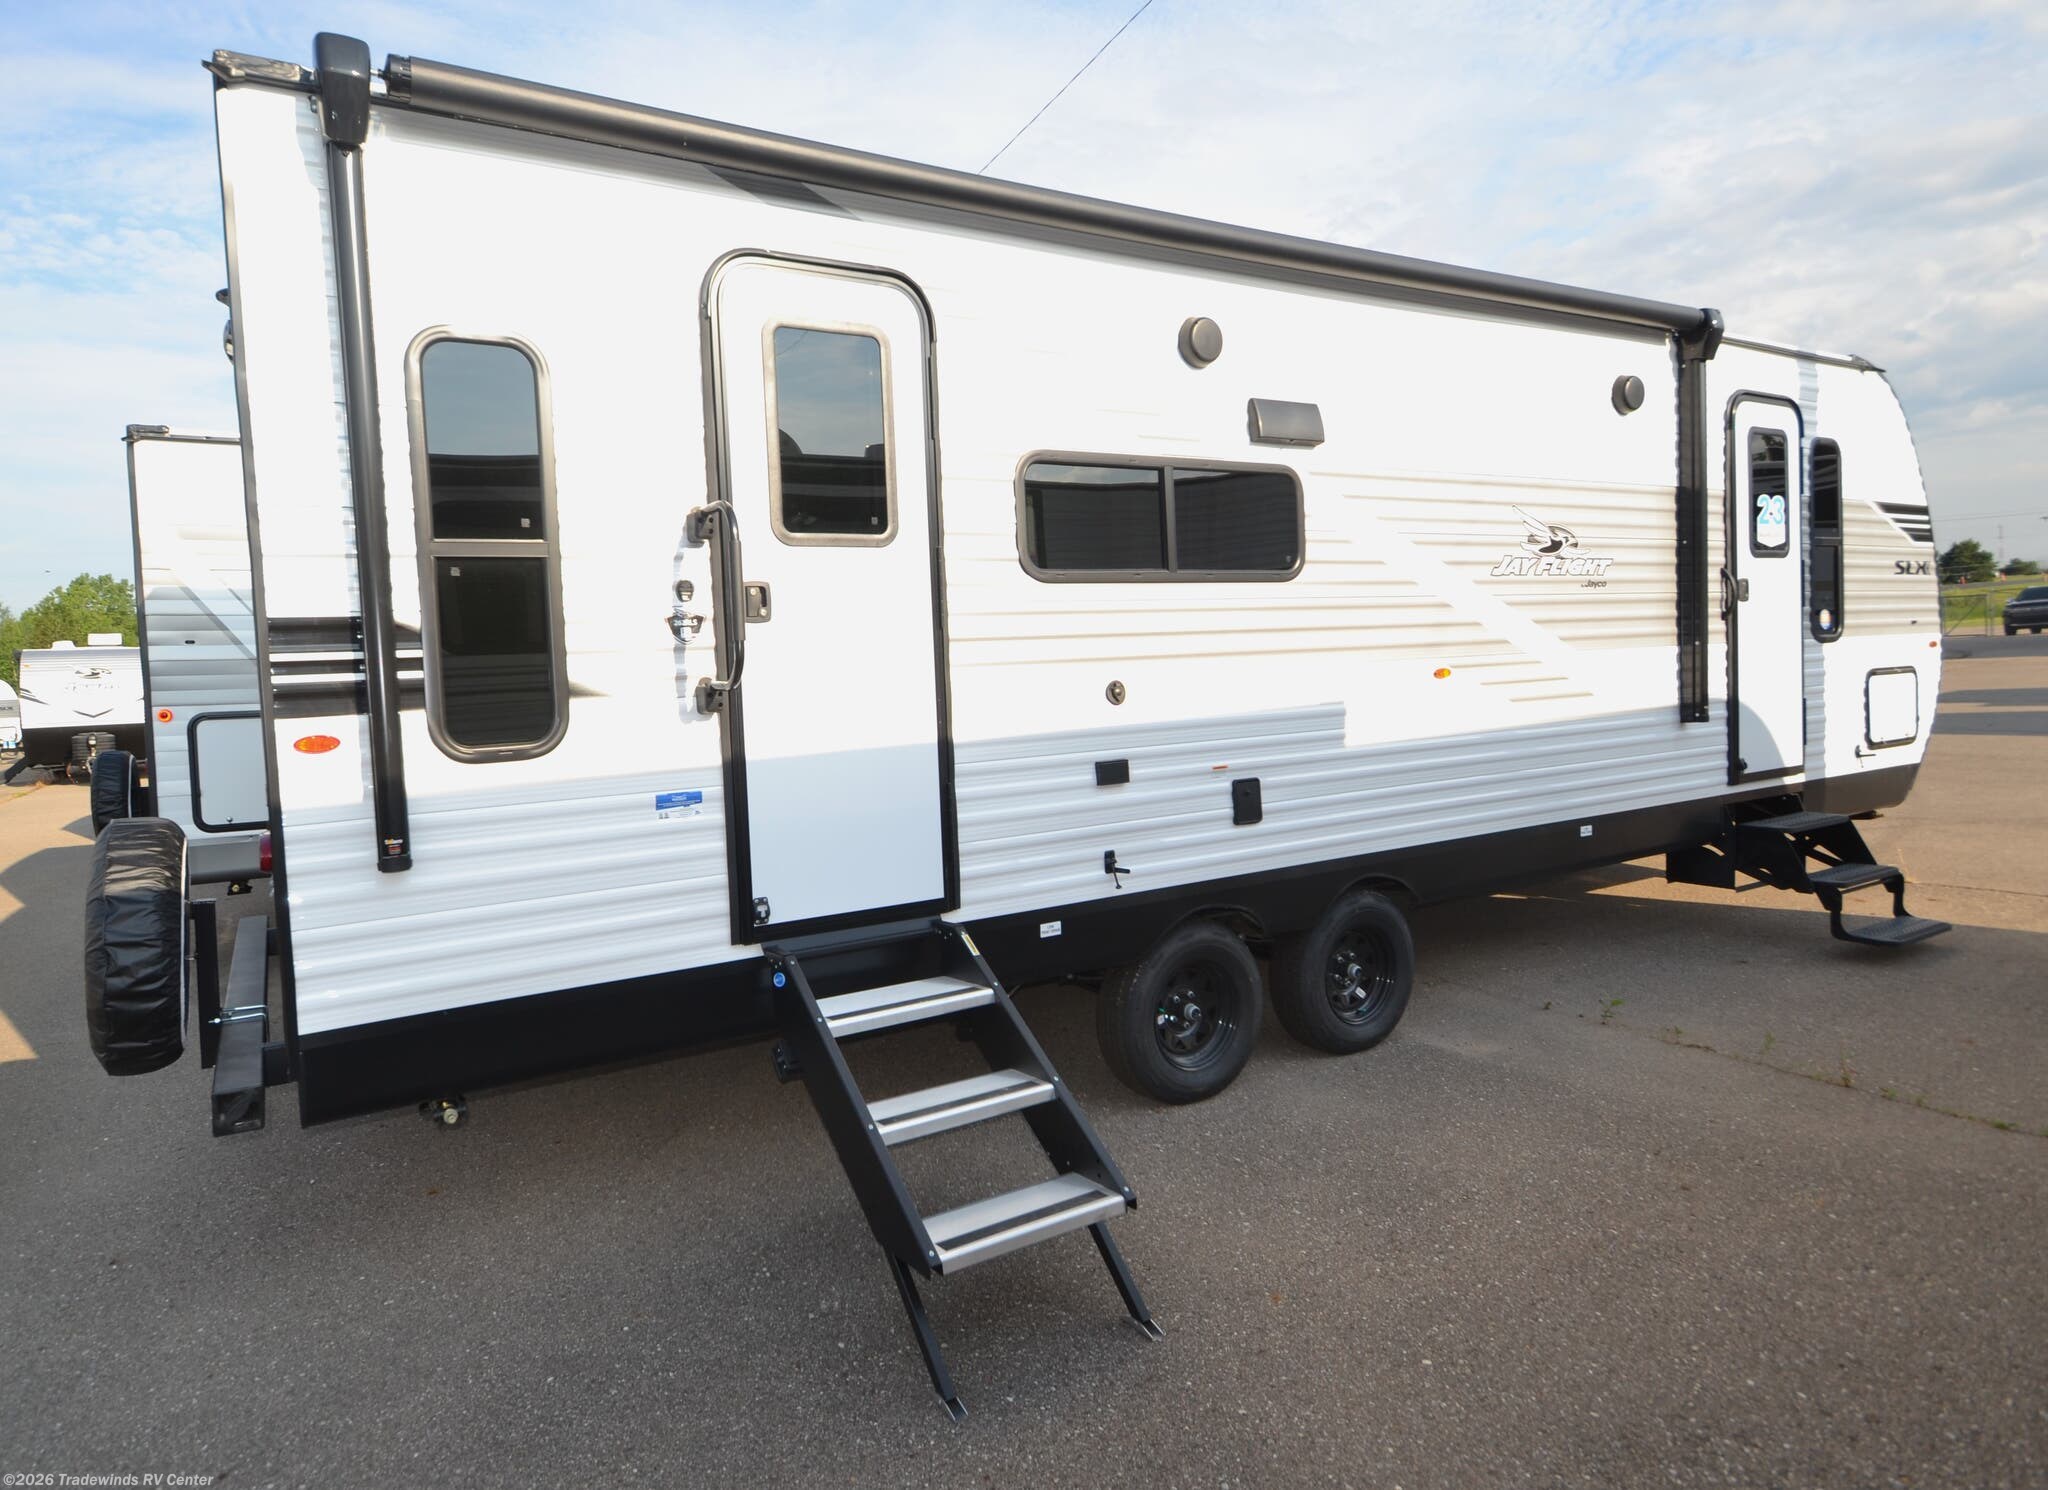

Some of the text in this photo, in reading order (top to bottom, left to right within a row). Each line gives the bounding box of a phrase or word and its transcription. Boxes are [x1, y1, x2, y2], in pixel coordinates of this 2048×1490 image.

[1757, 494, 1785, 526] 23
[1491, 555, 1614, 576] JAY FLIGHT
[1894, 560, 1928, 575] SLX
[1585, 579, 1607, 588] Jayco
